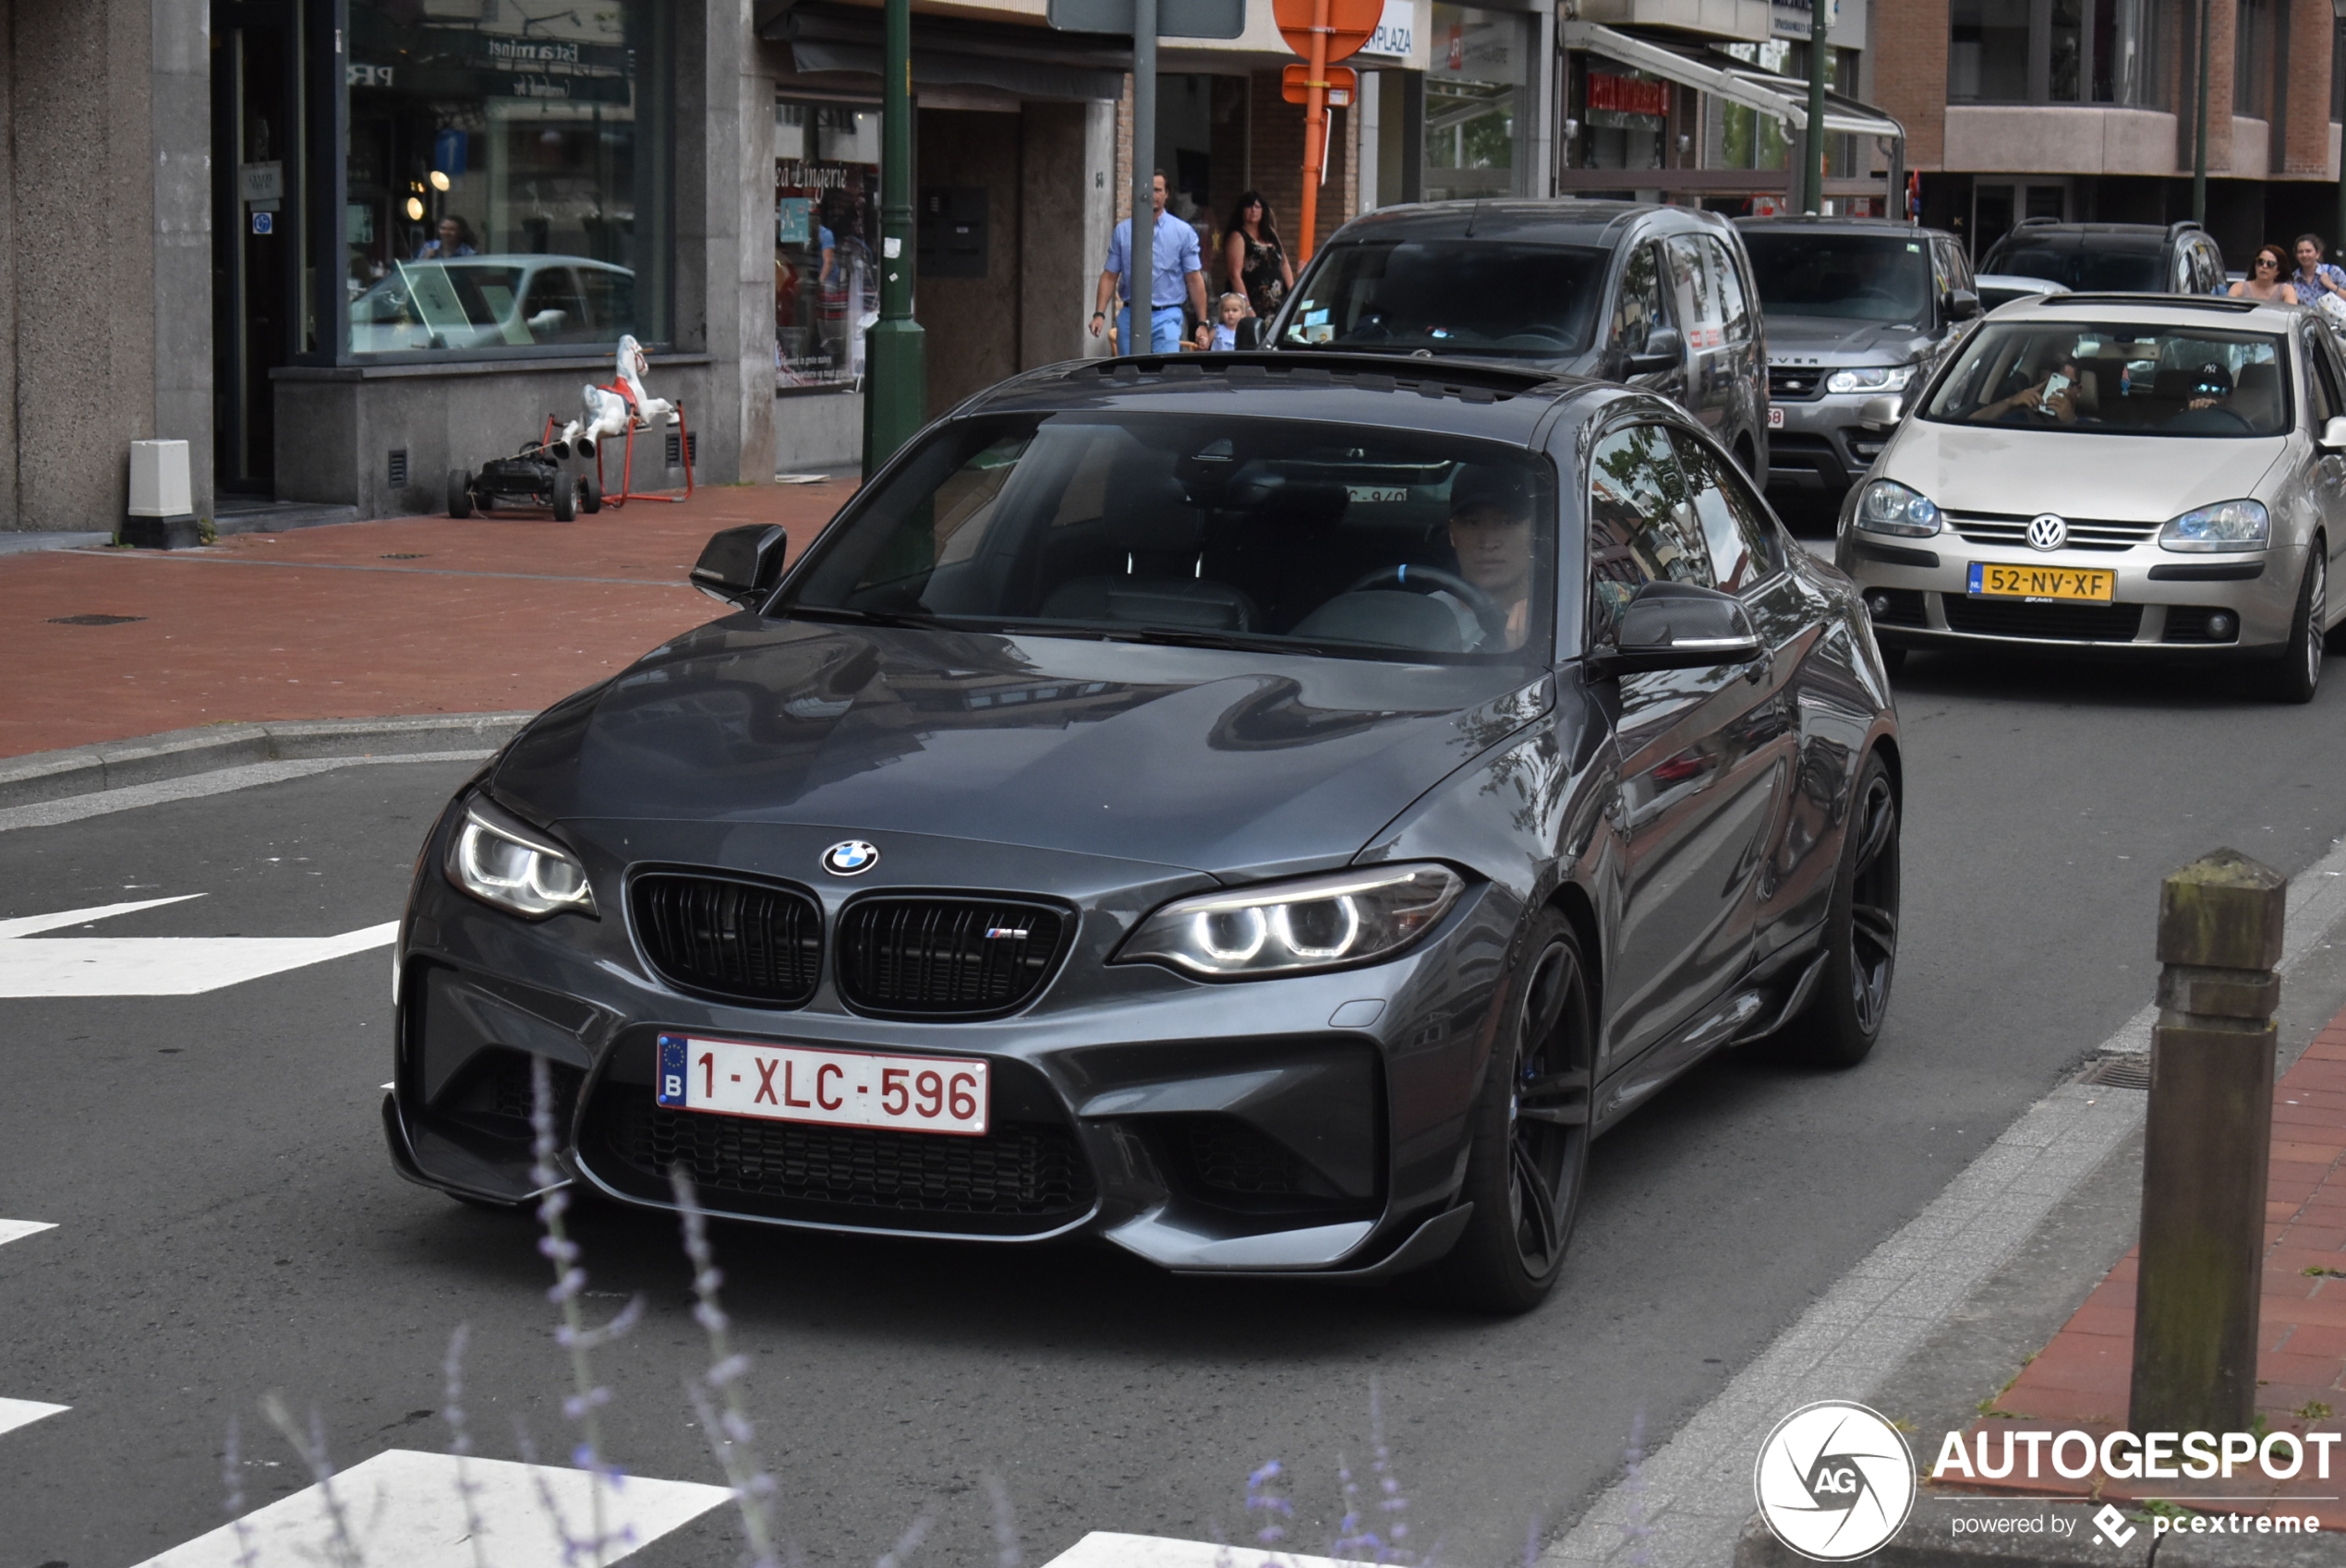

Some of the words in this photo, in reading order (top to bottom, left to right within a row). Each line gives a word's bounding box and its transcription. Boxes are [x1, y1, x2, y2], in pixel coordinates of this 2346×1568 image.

[1376, 26, 1411, 53] PLAZA
[792, 160, 848, 204] Lingerie
[1970, 581, 1981, 589] NL
[1990, 569, 2104, 596] 52-NV-XF
[664, 1074, 682, 1097] B
